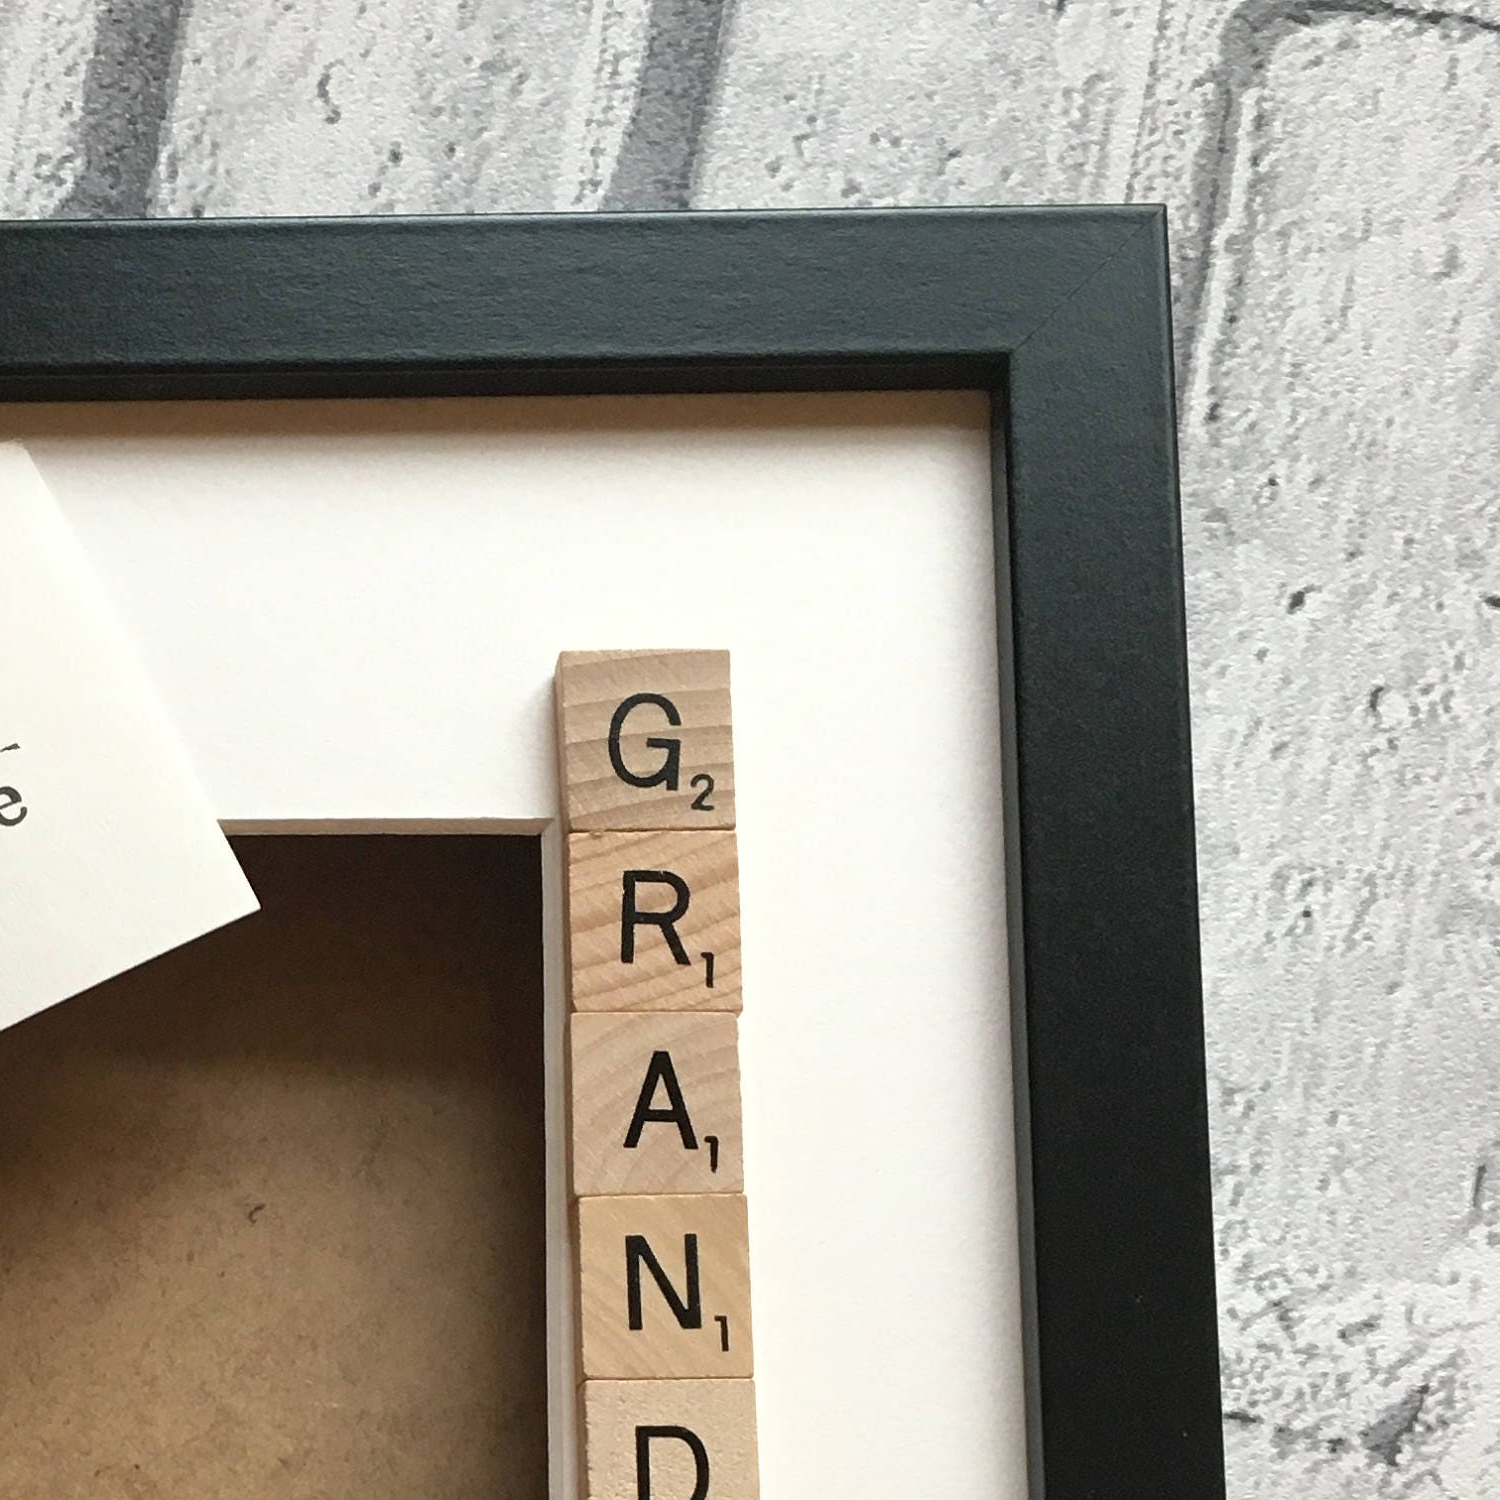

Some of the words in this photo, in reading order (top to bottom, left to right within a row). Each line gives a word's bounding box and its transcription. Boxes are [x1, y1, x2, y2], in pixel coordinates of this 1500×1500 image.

[690, 773, 715, 812] 2
[700, 951, 716, 989] 1
[703, 1135, 719, 1173] 1
[714, 1315, 729, 1352] 1
